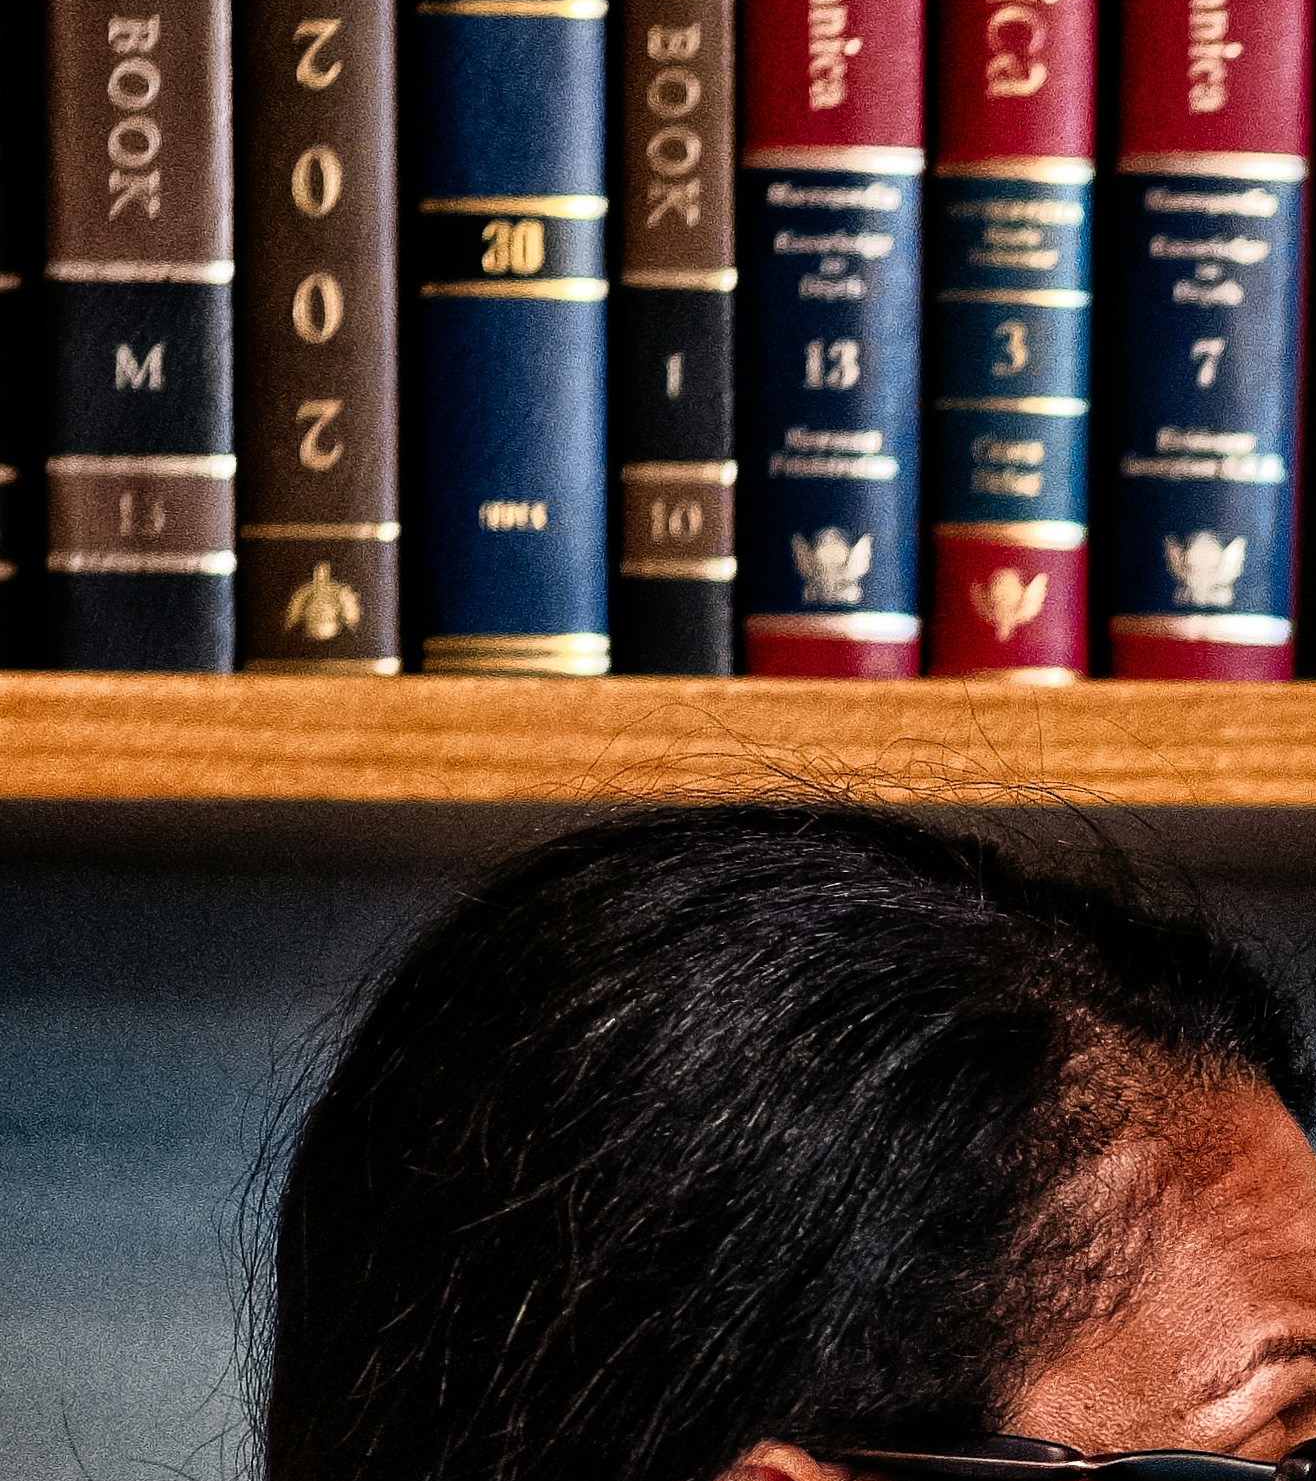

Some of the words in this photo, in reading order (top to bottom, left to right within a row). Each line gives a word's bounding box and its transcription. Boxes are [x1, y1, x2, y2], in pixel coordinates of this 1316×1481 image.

[107, 14, 163, 220] BOOK
[646, 17, 704, 231] BOOK
[479, 221, 547, 275] 30
[114, 343, 164, 391] M
[993, 321, 1030, 378] 3
[1191, 337, 1226, 389] 7
